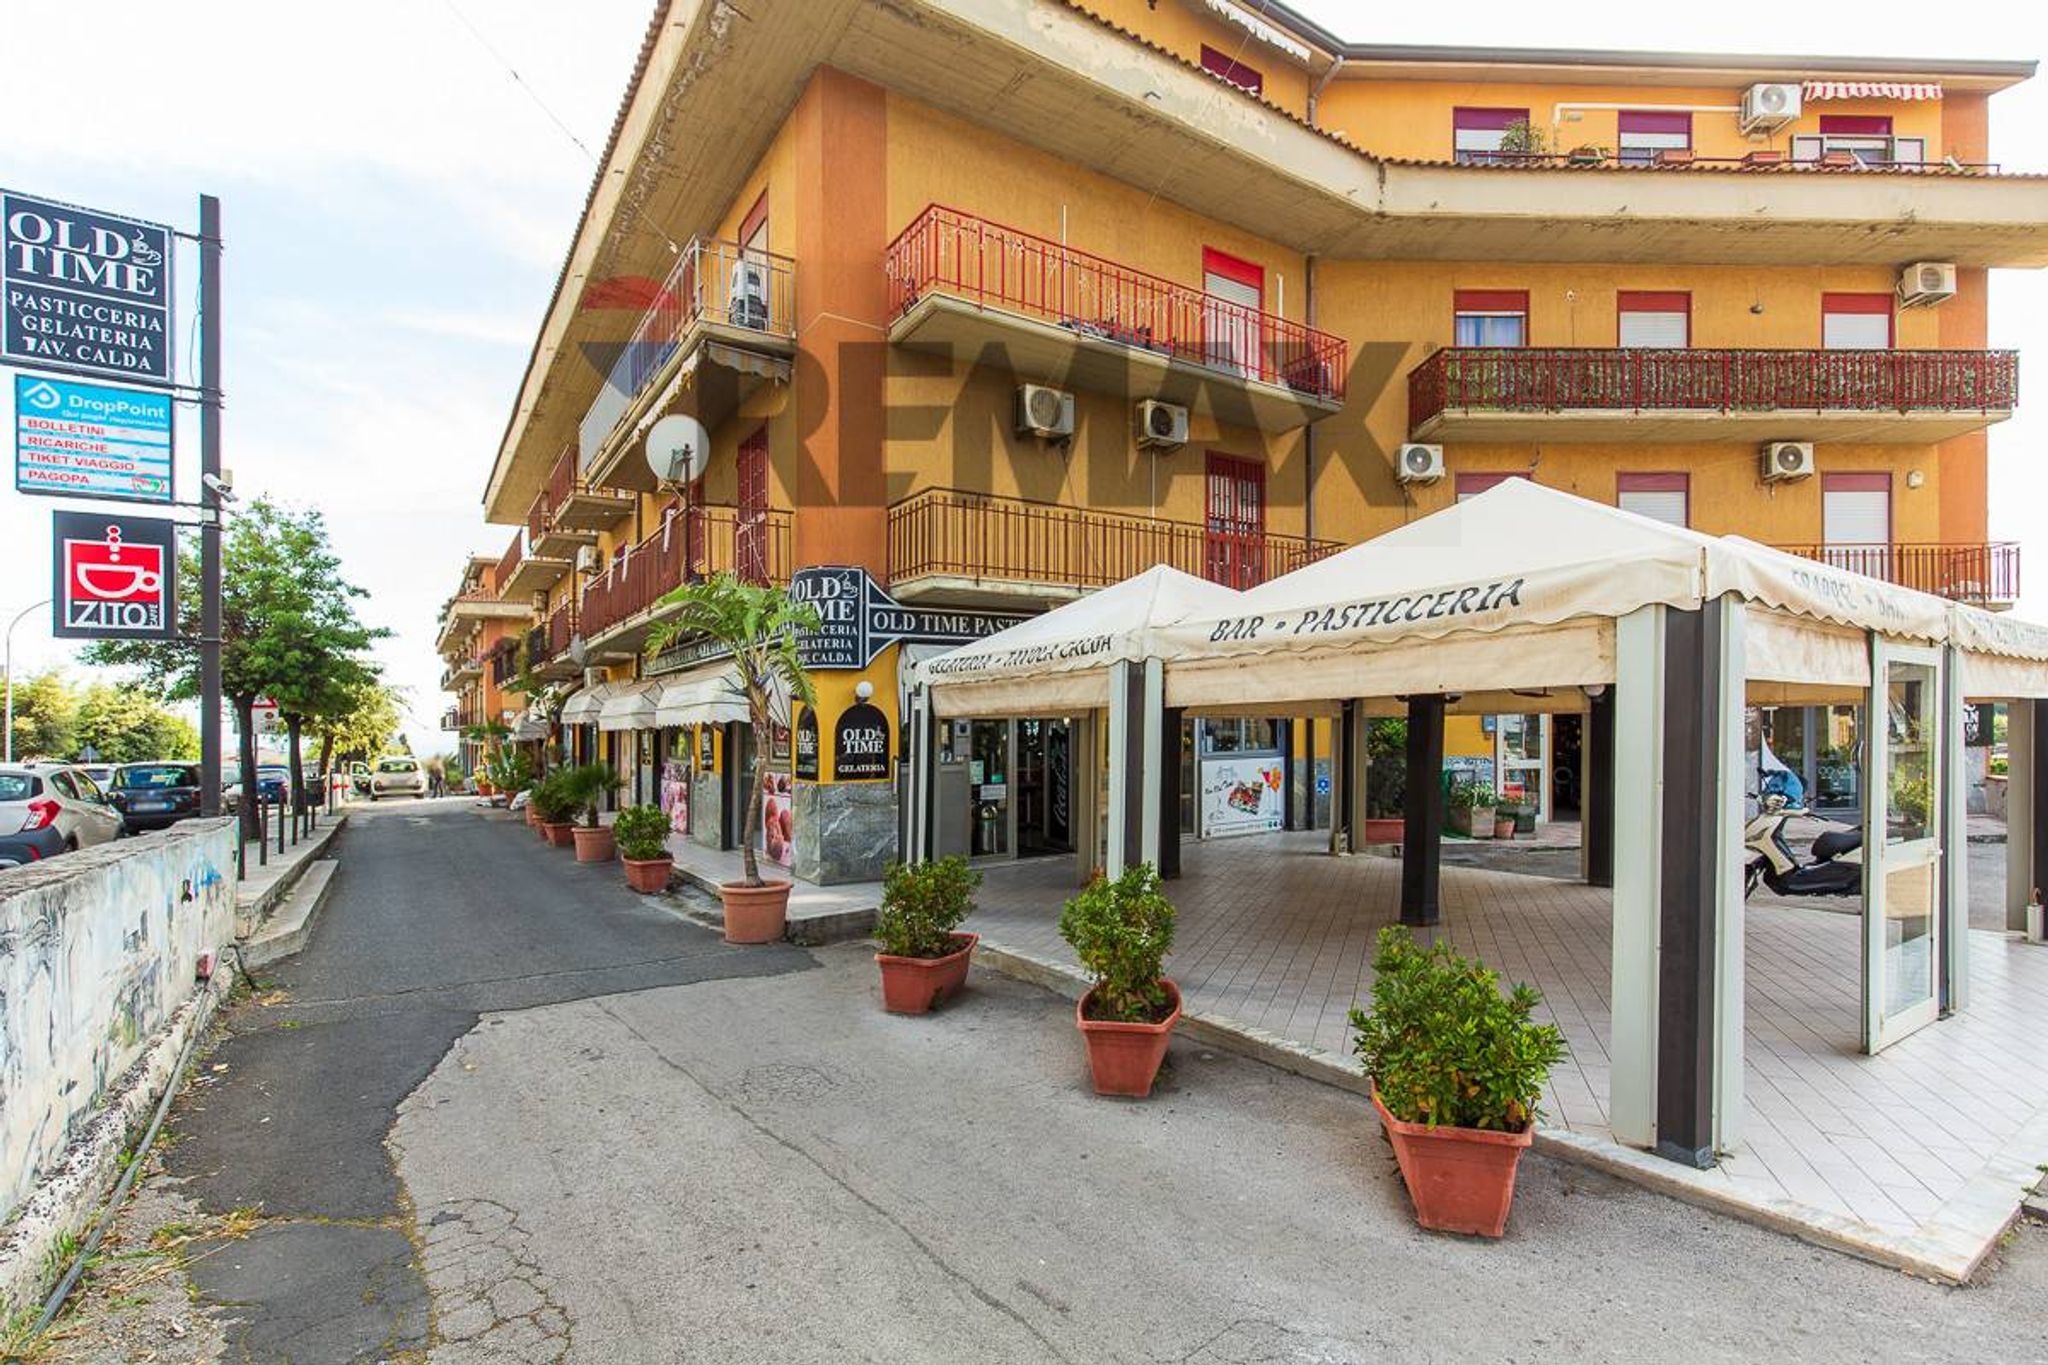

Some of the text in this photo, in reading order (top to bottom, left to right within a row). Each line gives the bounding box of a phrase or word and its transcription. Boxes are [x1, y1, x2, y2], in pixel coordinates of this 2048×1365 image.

[9, 211, 129, 260] OLD
[9, 241, 157, 297] TIME
[11, 290, 163, 332] PASTICCERIA
[22, 315, 152, 351] GELATERIA
[77, 346, 151, 370] CALDA
[69, 394, 165, 419] DropPoint
[27, 419, 104, 435] BOLLETINI
[27, 436, 108, 453] RICARICHE
[28, 452, 135, 471] TIKET VIAGGIO
[28, 470, 89, 484] PAGOPA
[795, 576, 841, 601] OLD
[73, 600, 148, 626] ZITO
[797, 599, 855, 622] ME
[1209, 615, 1265, 642] BAR
[1292, 577, 1526, 635] PASTICCERIA
[873, 611, 1025, 635] OLD TIME PAST
[812, 652, 852, 663] CALDA
[842, 728, 875, 742] OLD
[843, 740, 885, 754] TIME
[838, 764, 886, 774] GELATERIA
